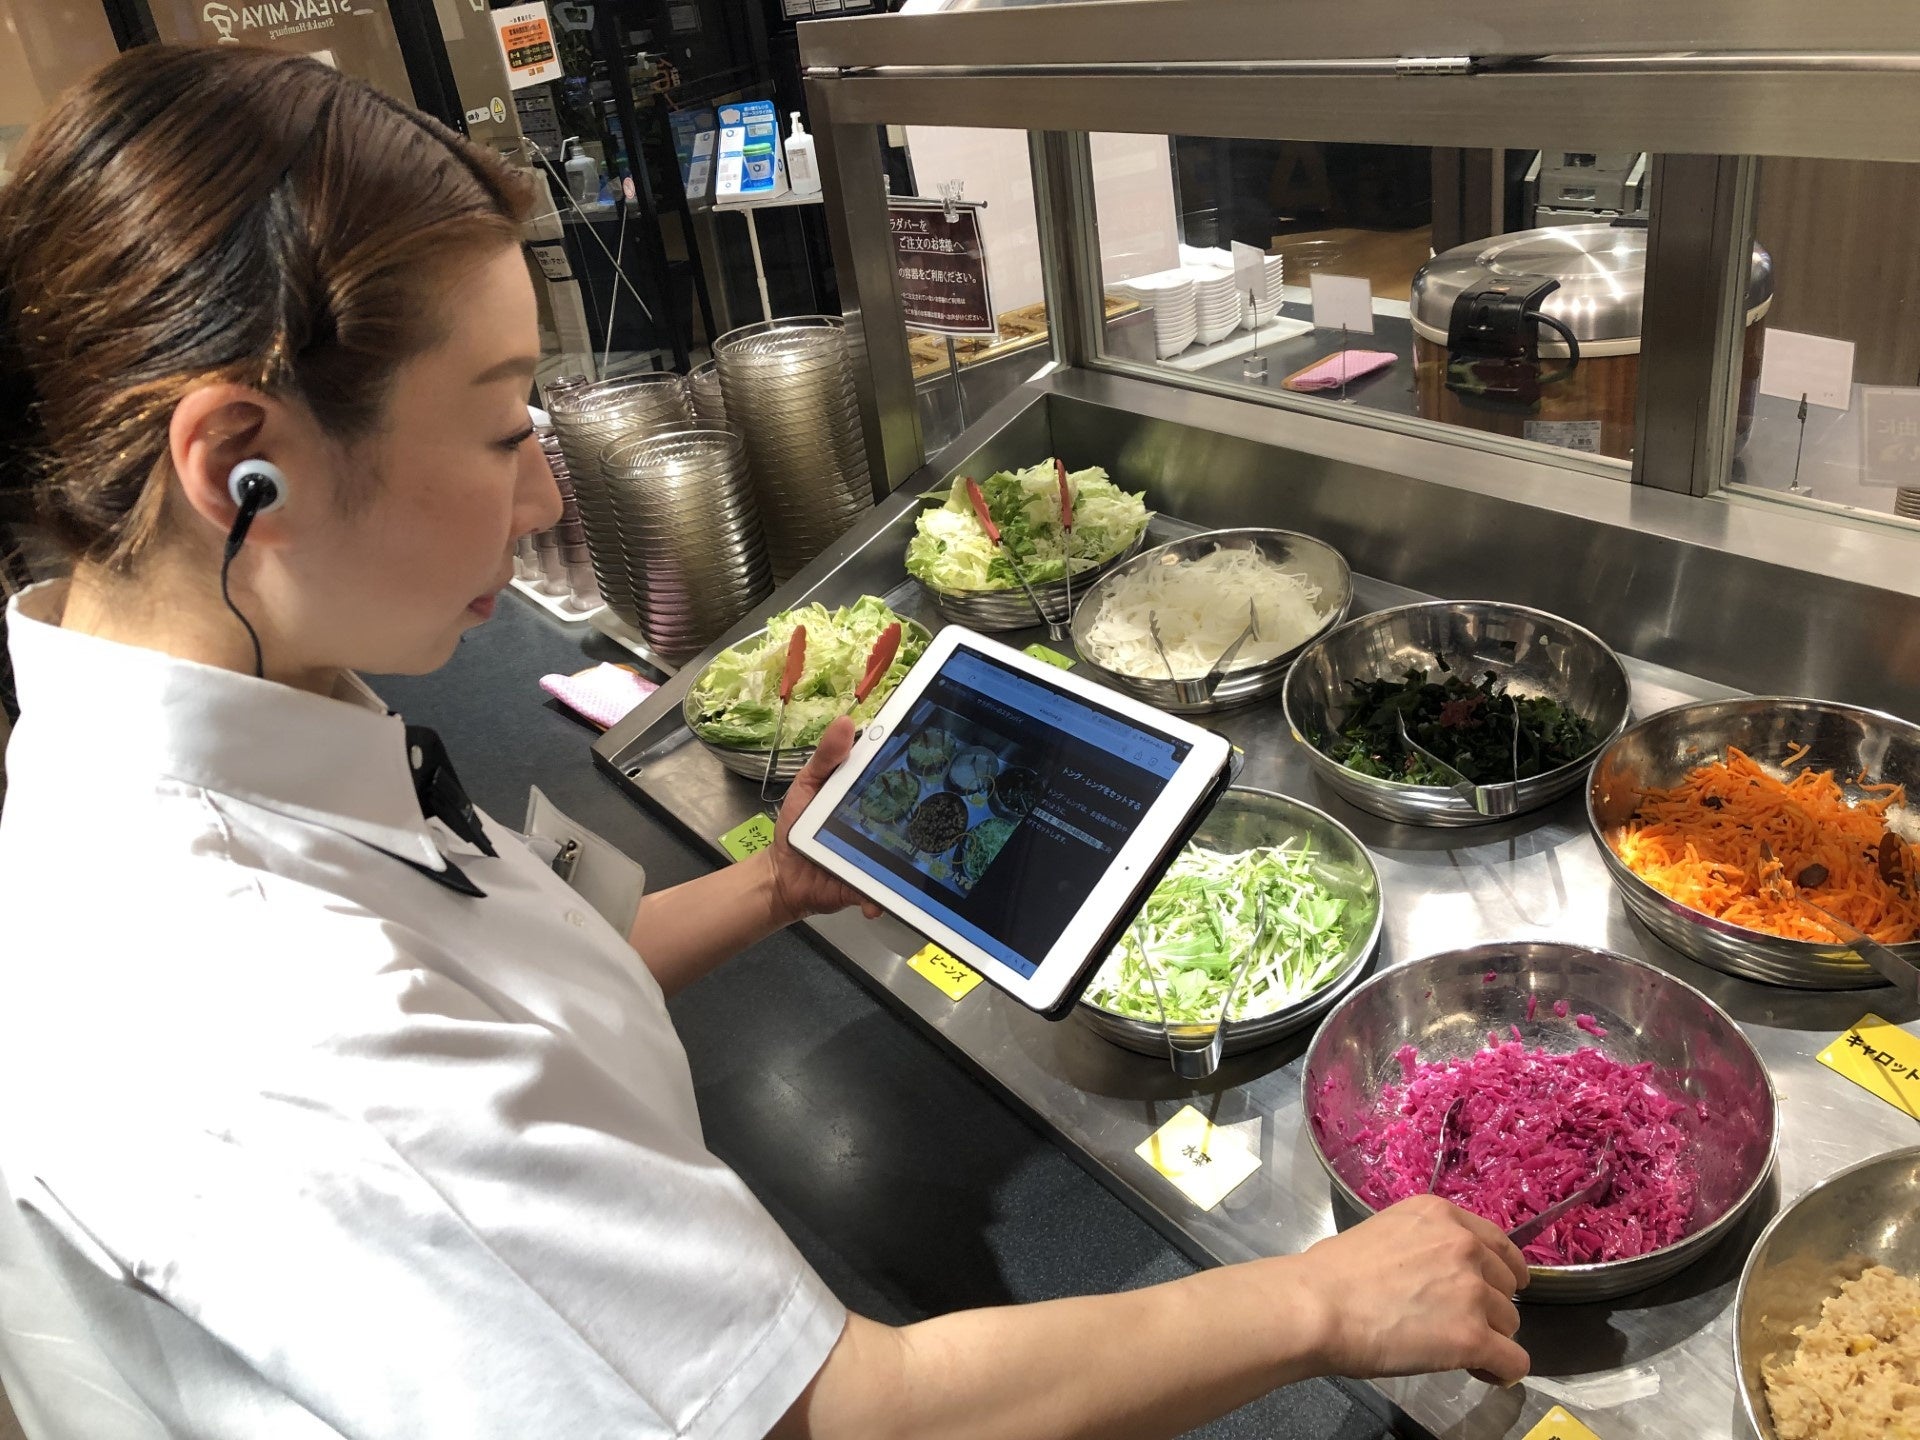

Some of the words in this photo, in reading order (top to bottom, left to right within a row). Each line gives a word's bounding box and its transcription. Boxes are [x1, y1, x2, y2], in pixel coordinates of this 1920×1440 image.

[899, 236, 965, 252] ご注文のお客様へ
[738, 835, 758, 854] レタス
[930, 954, 967, 983] ビーンズ
[1846, 1034, 1920, 1080] キャロット
